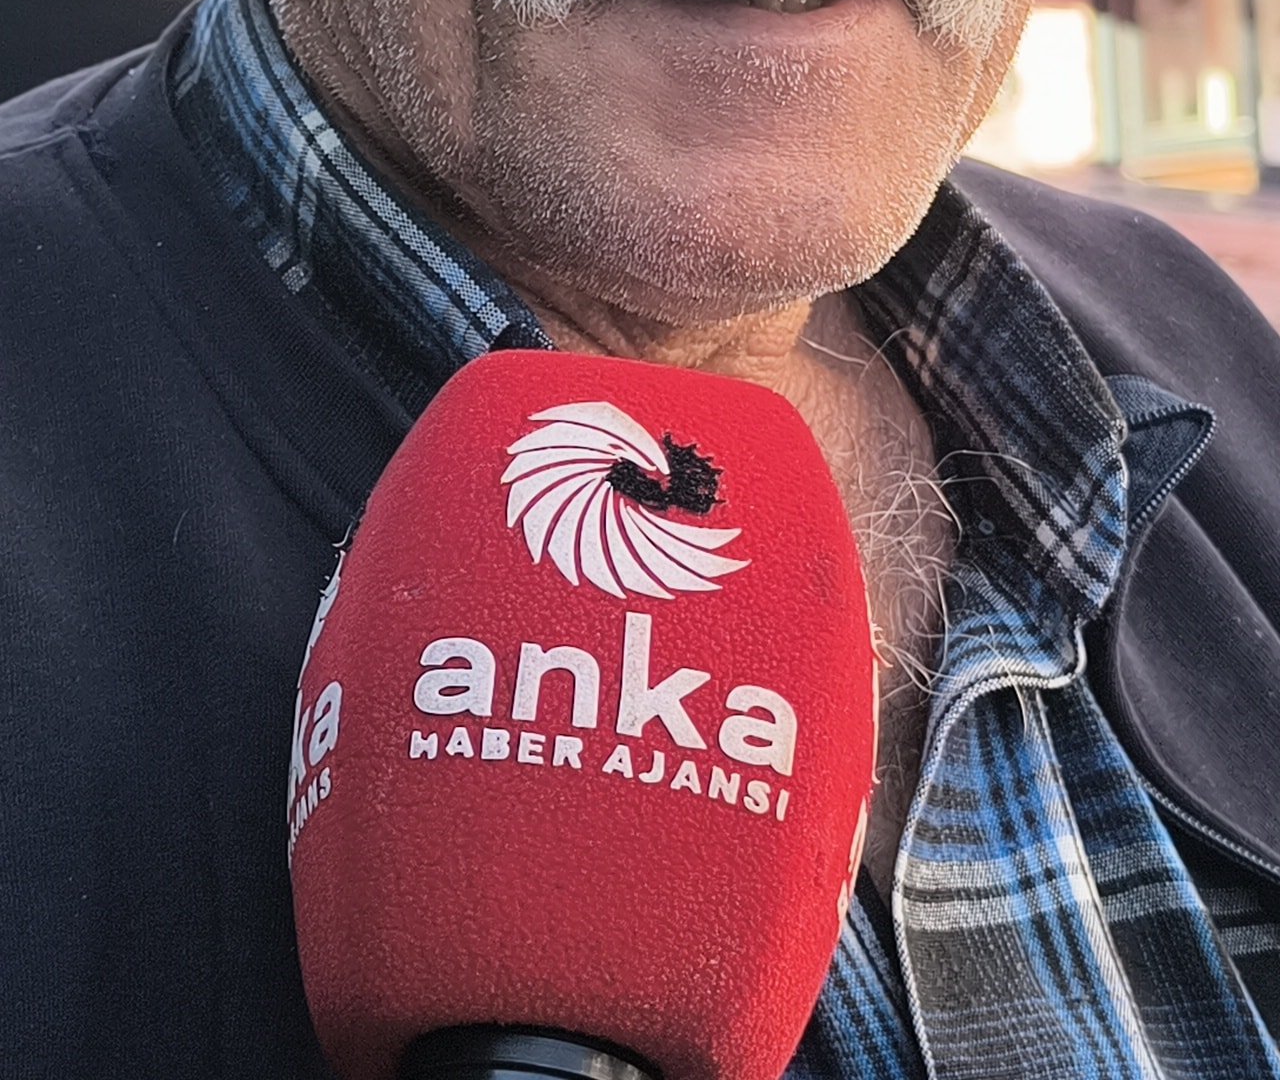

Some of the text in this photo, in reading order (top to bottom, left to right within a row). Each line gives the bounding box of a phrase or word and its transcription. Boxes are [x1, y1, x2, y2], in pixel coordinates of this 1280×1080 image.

[413, 611, 798, 777] anka
[408, 726, 790, 821] HABER AJANSI
